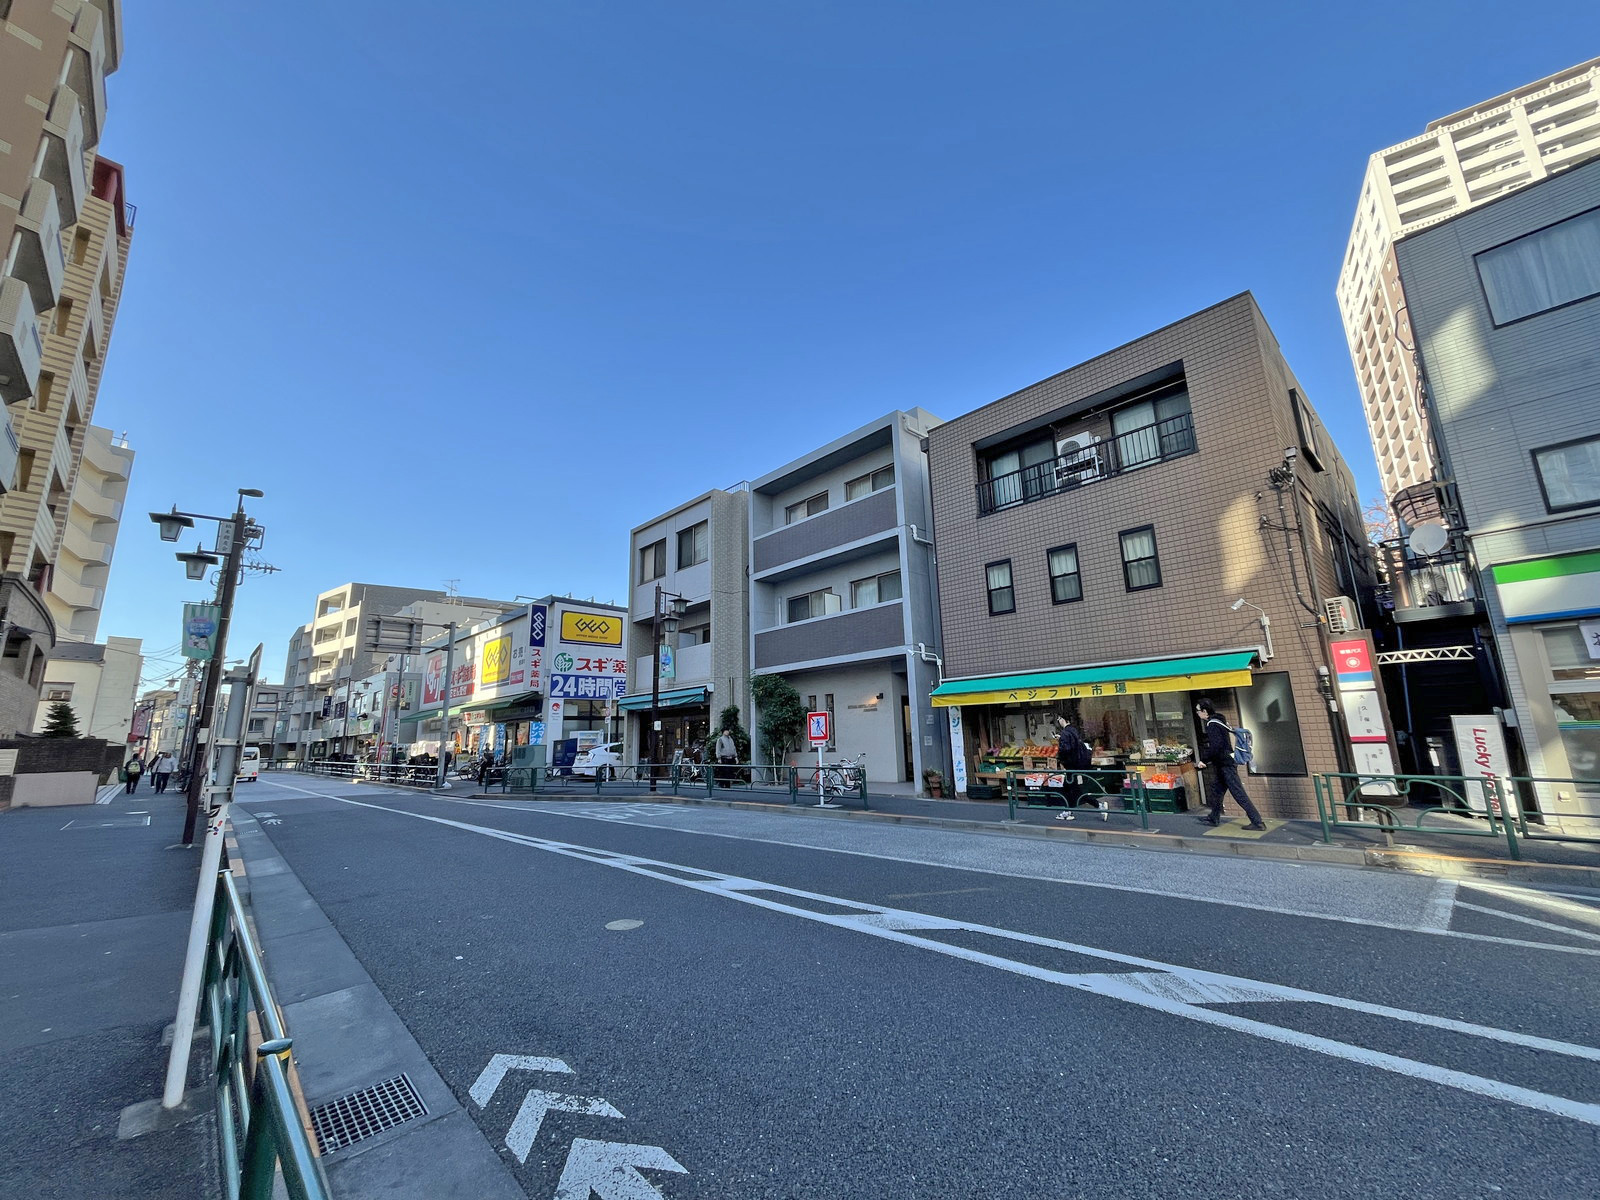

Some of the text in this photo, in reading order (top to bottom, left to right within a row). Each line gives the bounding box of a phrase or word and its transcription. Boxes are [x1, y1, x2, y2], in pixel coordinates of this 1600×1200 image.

[532, 612, 544, 640] GEO
[575, 618, 610, 634] GEO
[486, 643, 508, 669] GEO
[530, 648, 542, 688] スギ薬局
[1009, 682, 1127, 700] ベジフル市場
[1473, 728, 1492, 769] Lucky
